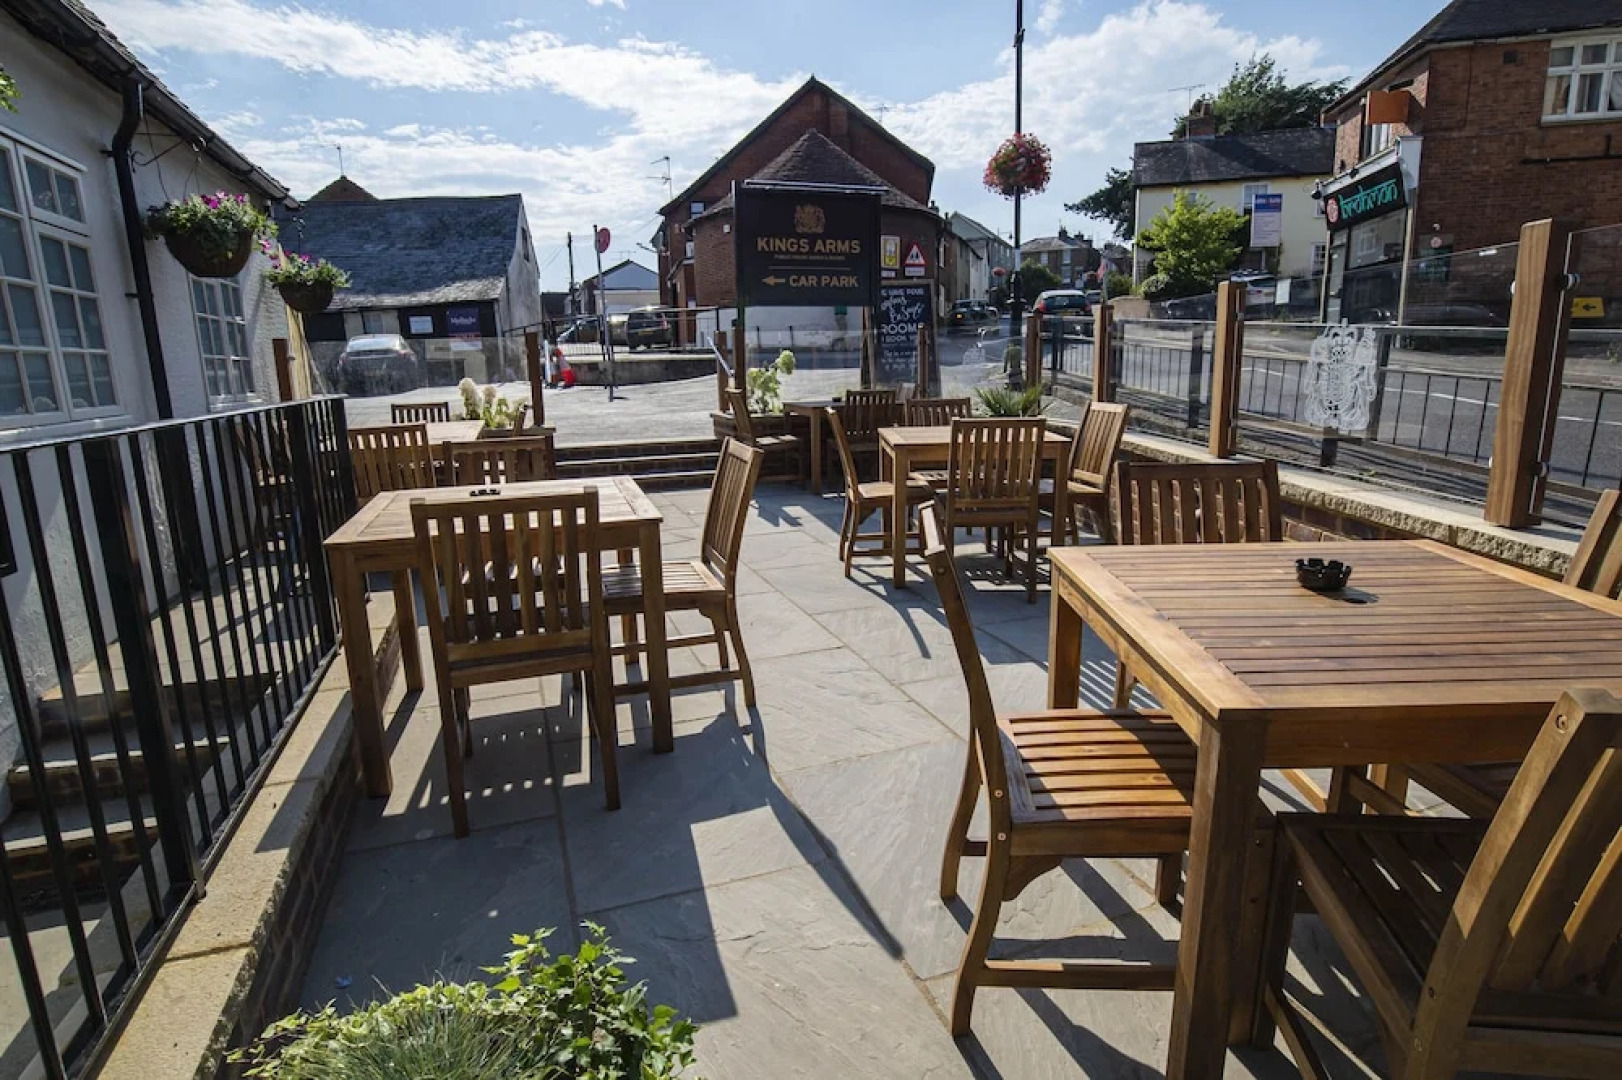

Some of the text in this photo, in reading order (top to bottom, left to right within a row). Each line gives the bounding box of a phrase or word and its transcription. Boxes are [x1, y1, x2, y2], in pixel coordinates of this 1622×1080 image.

[757, 237, 861, 253] KINGS ARMS
[789, 275, 859, 287] CAR PARK
[881, 322, 918, 335] ROOM
